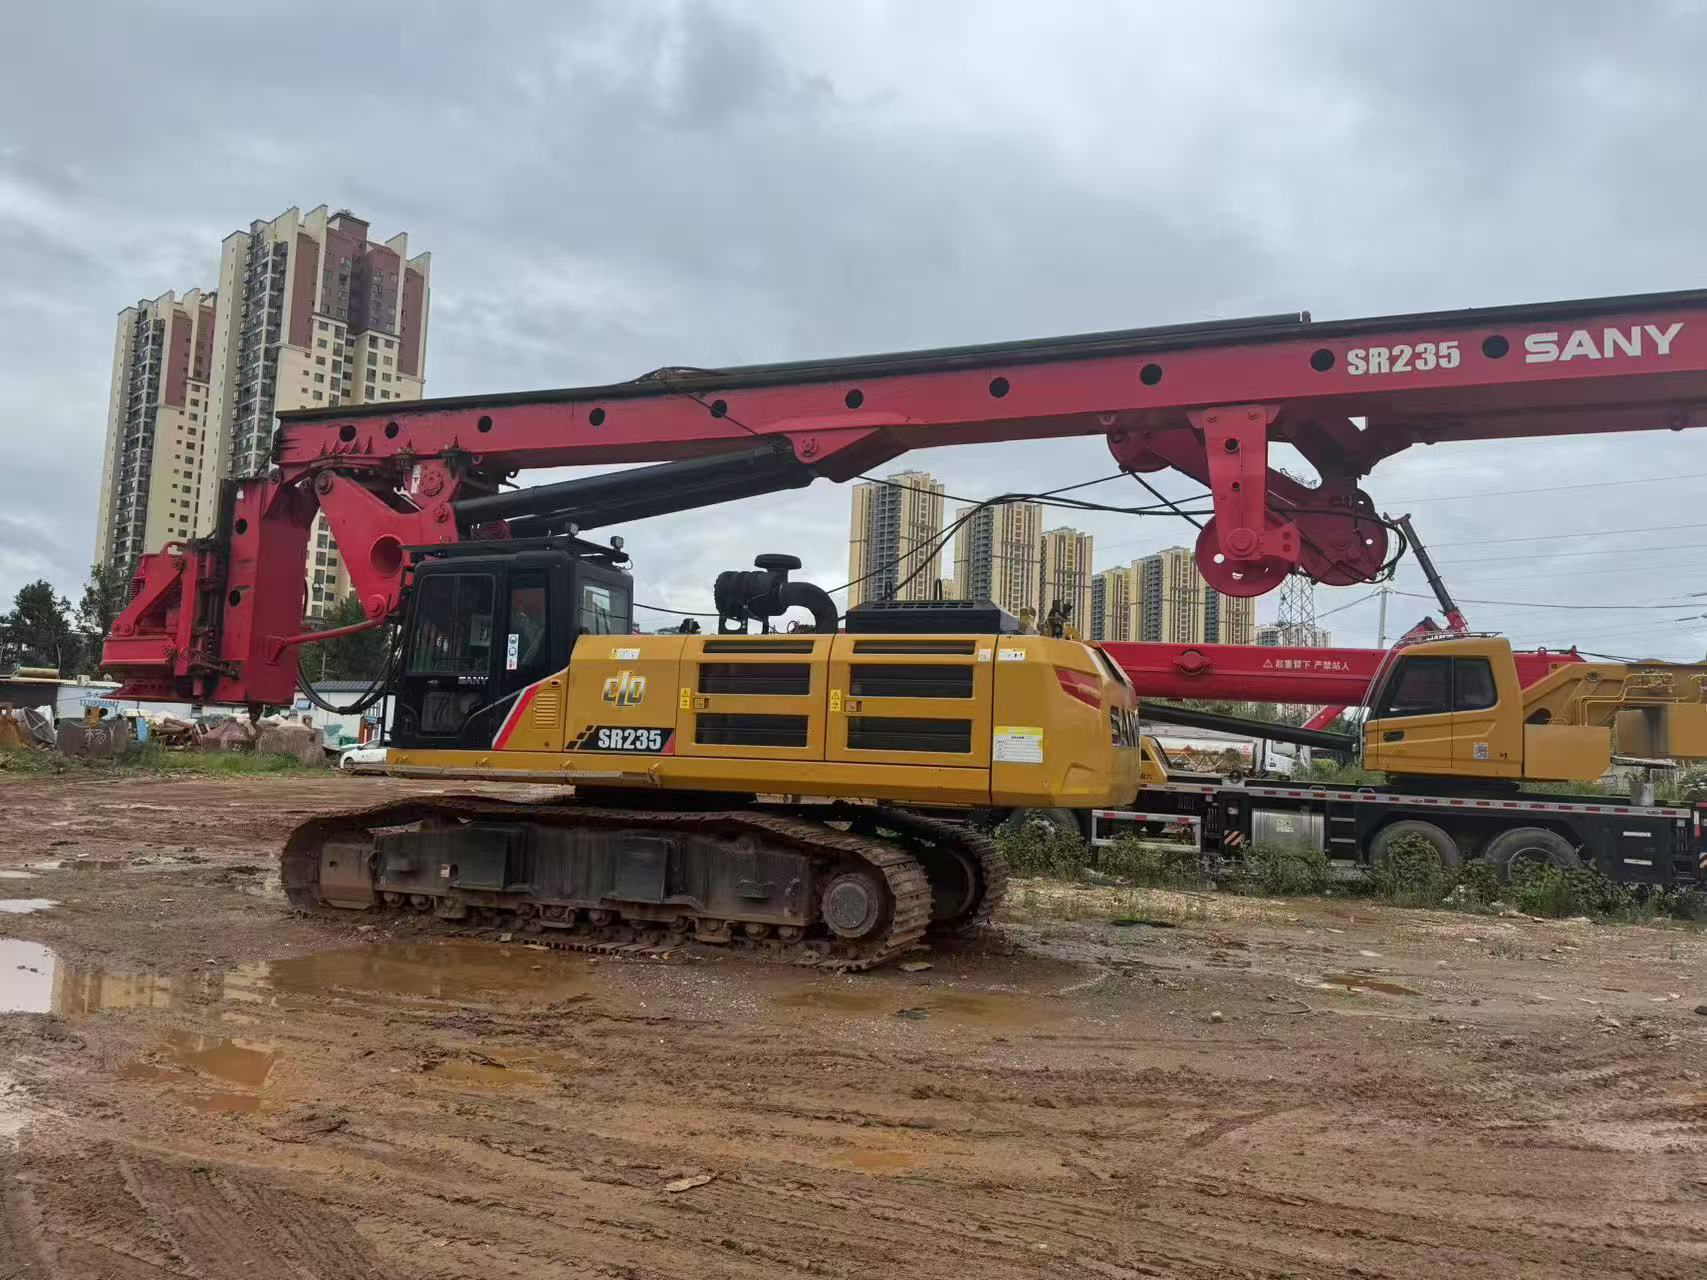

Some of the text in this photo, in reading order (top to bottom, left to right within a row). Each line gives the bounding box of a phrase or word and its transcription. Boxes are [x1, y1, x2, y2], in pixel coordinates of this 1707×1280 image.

[1347, 341, 1461, 375] SR235
[1524, 322, 1685, 363] SANY
[598, 728, 661, 750] SR235
